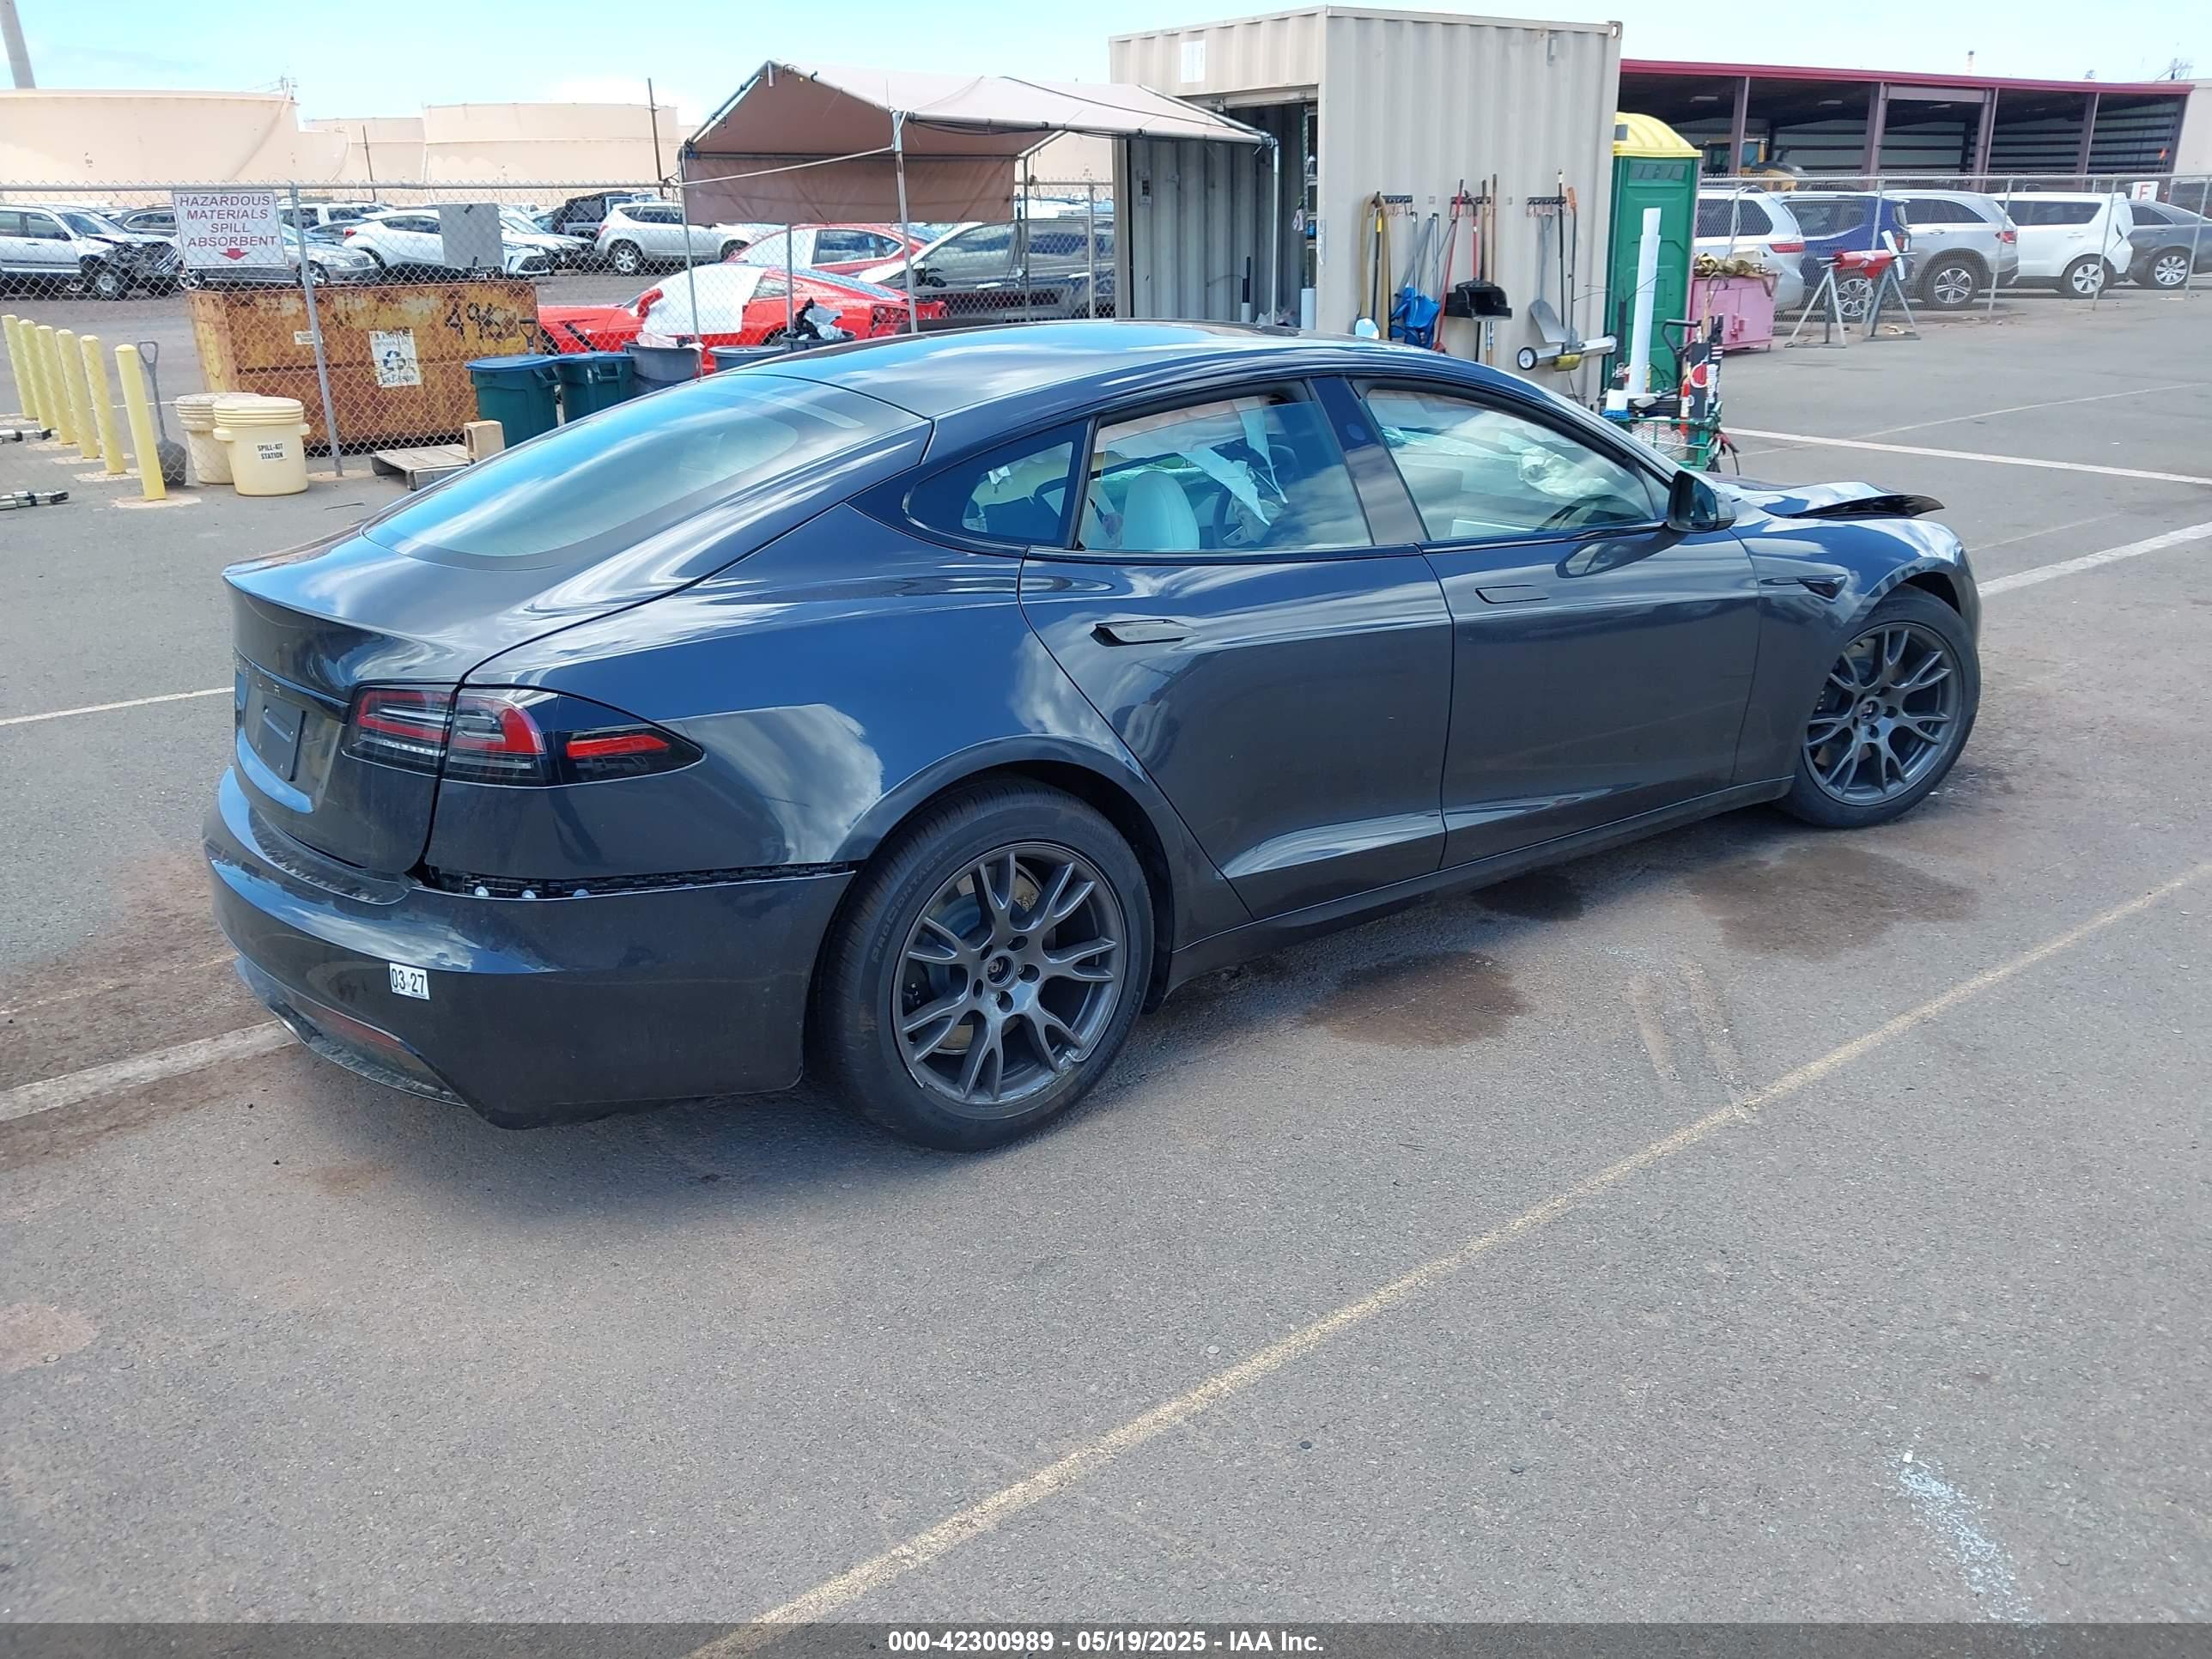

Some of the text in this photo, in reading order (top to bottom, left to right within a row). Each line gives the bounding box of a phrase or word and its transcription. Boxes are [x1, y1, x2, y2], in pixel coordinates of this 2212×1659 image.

[179, 196, 270, 207] HAZARDOUS
[187, 210, 269, 220] MATERIALS
[210, 223, 251, 233] SPILL
[186, 235, 277, 247] ABSORBENT
[257, 442, 283, 452] SPILL-KIT
[260, 452, 283, 460] STATION
[392, 968, 425, 994] 03 27
